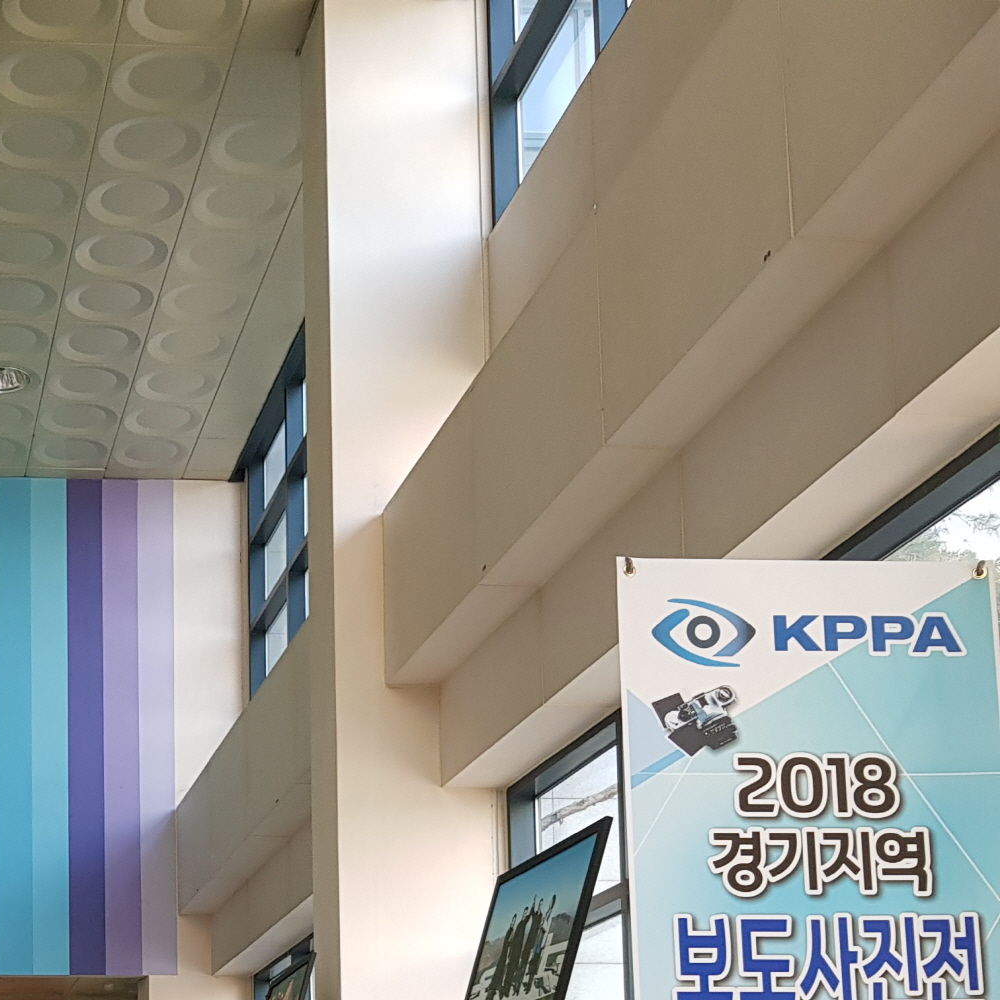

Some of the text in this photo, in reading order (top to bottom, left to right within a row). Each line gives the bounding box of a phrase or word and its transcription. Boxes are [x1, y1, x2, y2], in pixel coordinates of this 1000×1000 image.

[773, 615, 962, 653] KPPA
[736, 757, 897, 814] 2018
[710, 830, 930, 894] 경기지역
